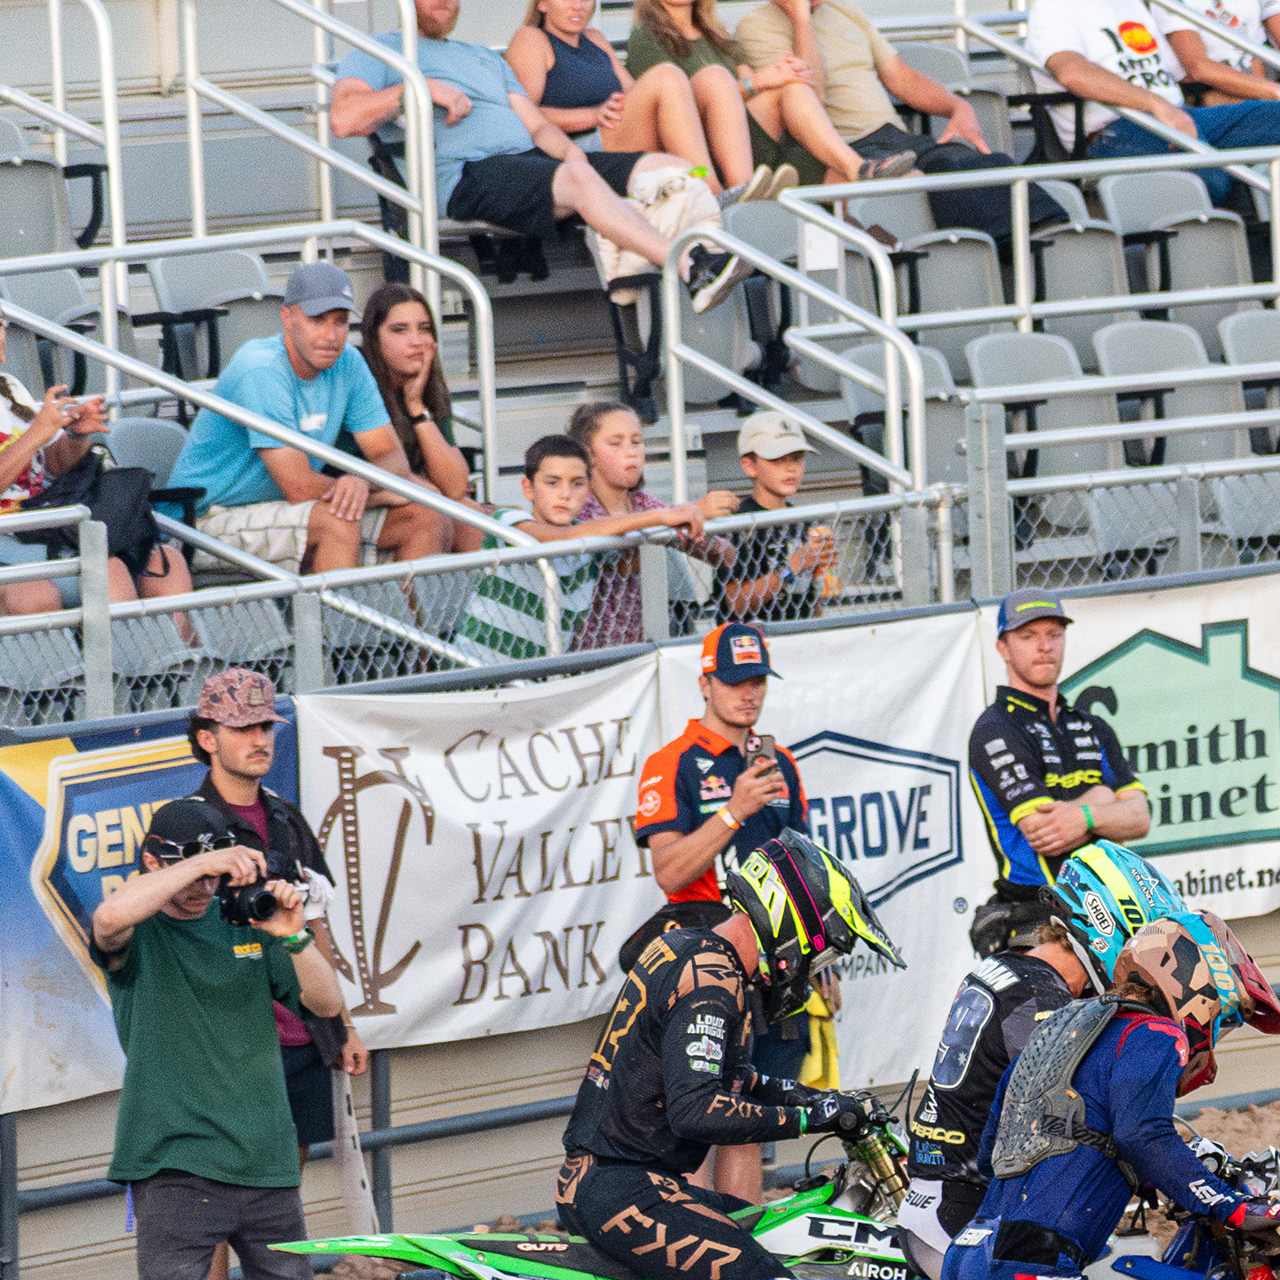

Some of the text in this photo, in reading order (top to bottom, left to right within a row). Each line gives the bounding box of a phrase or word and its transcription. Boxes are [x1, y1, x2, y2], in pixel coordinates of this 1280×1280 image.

[444, 717, 638, 803] CACHE
[1149, 773, 1279, 827] inet
[1088, 897, 1110, 931] SHOEI
[1118, 895, 1148, 937] 10
[453, 921, 607, 1006] BANK
[517, 1243, 570, 1252] GUTS
[847, 1261, 908, 1280] AIROH
